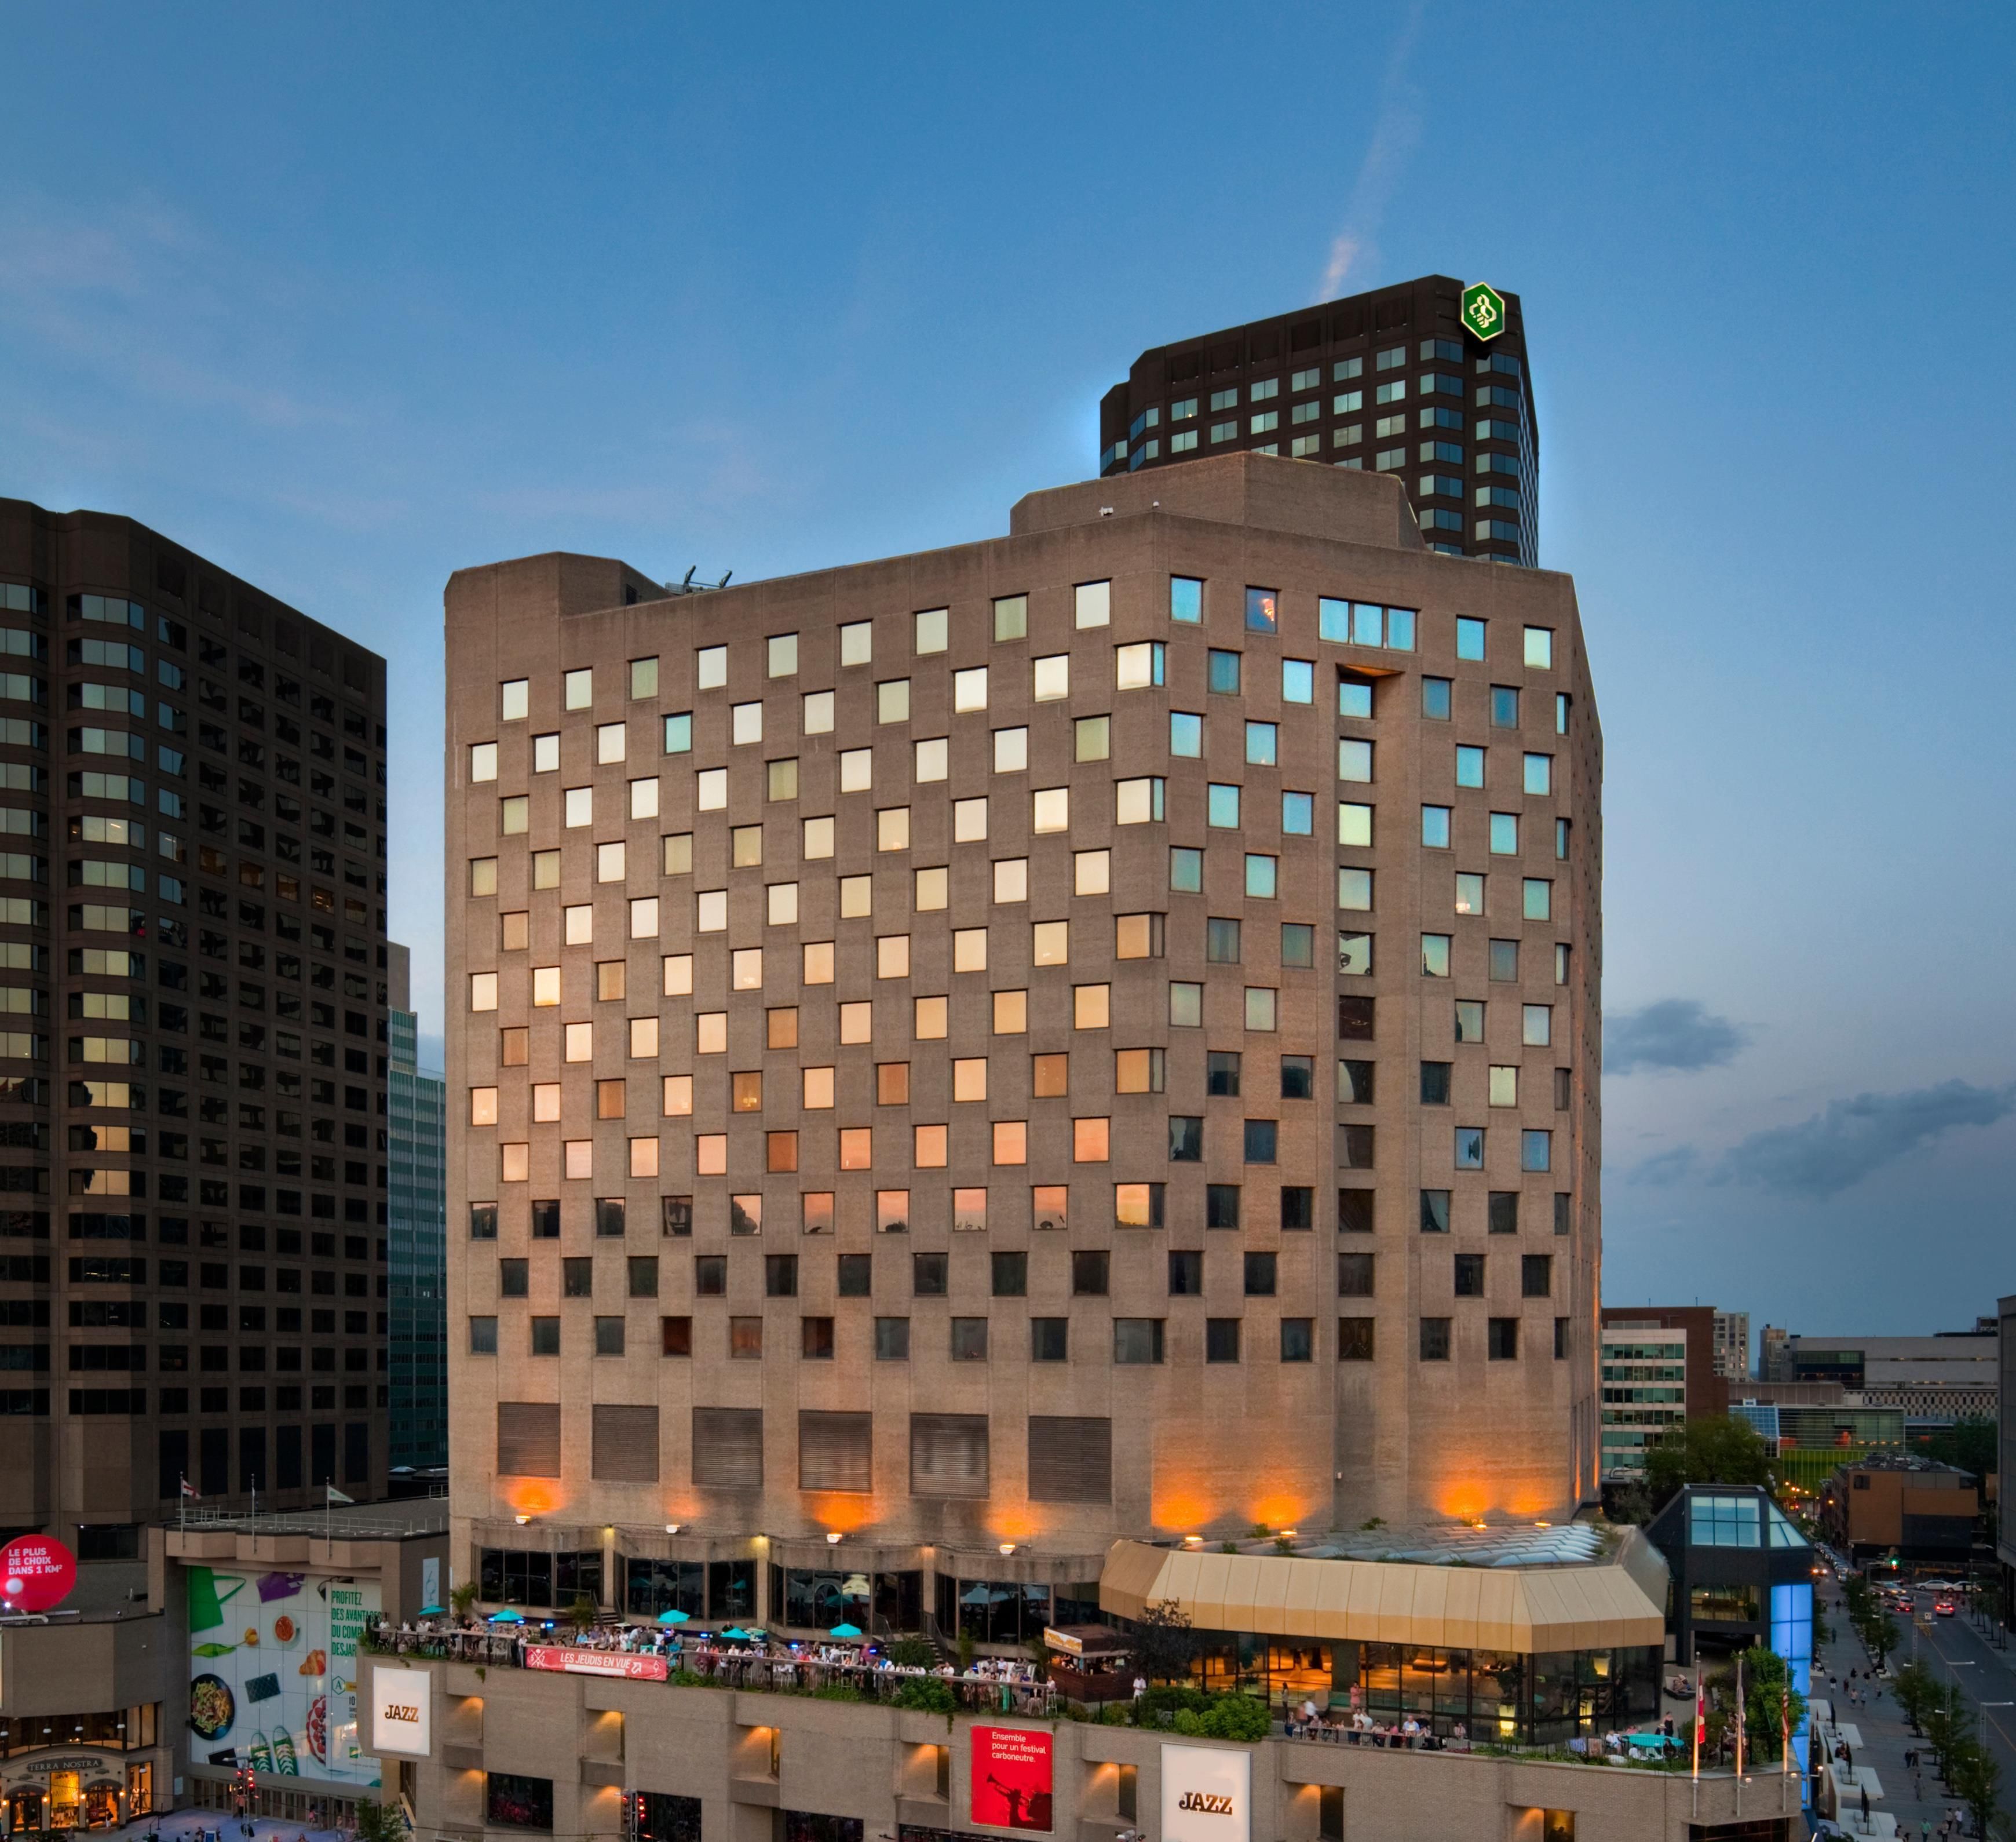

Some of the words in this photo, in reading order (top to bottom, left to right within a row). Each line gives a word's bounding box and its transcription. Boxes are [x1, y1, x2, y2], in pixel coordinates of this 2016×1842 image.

[9, 1549, 20, 1557] LE
[23, 1547, 47, 1556] PLUS
[9, 1558, 21, 1566] DE
[24, 1556, 51, 1565] CHOIX
[9, 1566, 34, 1575] DANS
[36, 1566, 42, 1574] 1
[332, 1591, 362, 1605] PROFITEZ
[332, 1608, 344, 1621] DES
[332, 1625, 341, 1637] DU
[560, 1653, 574, 1662] LES
[575, 1654, 601, 1666] JEUDIS
[603, 1657, 613, 1666] EN
[616, 1658, 630, 1669] VUE
[385, 1705, 419, 1723] JAZZ
[992, 1731, 1026, 1742] Ensemble
[1020, 1743, 1046, 1754] festival
[992, 1752, 1036, 1762] carboneutre.
[30, 1763, 59, 1771] TERRA
[63, 1760, 99, 1769] NOSTRA
[1178, 1792, 1233, 1815] JAZZ
